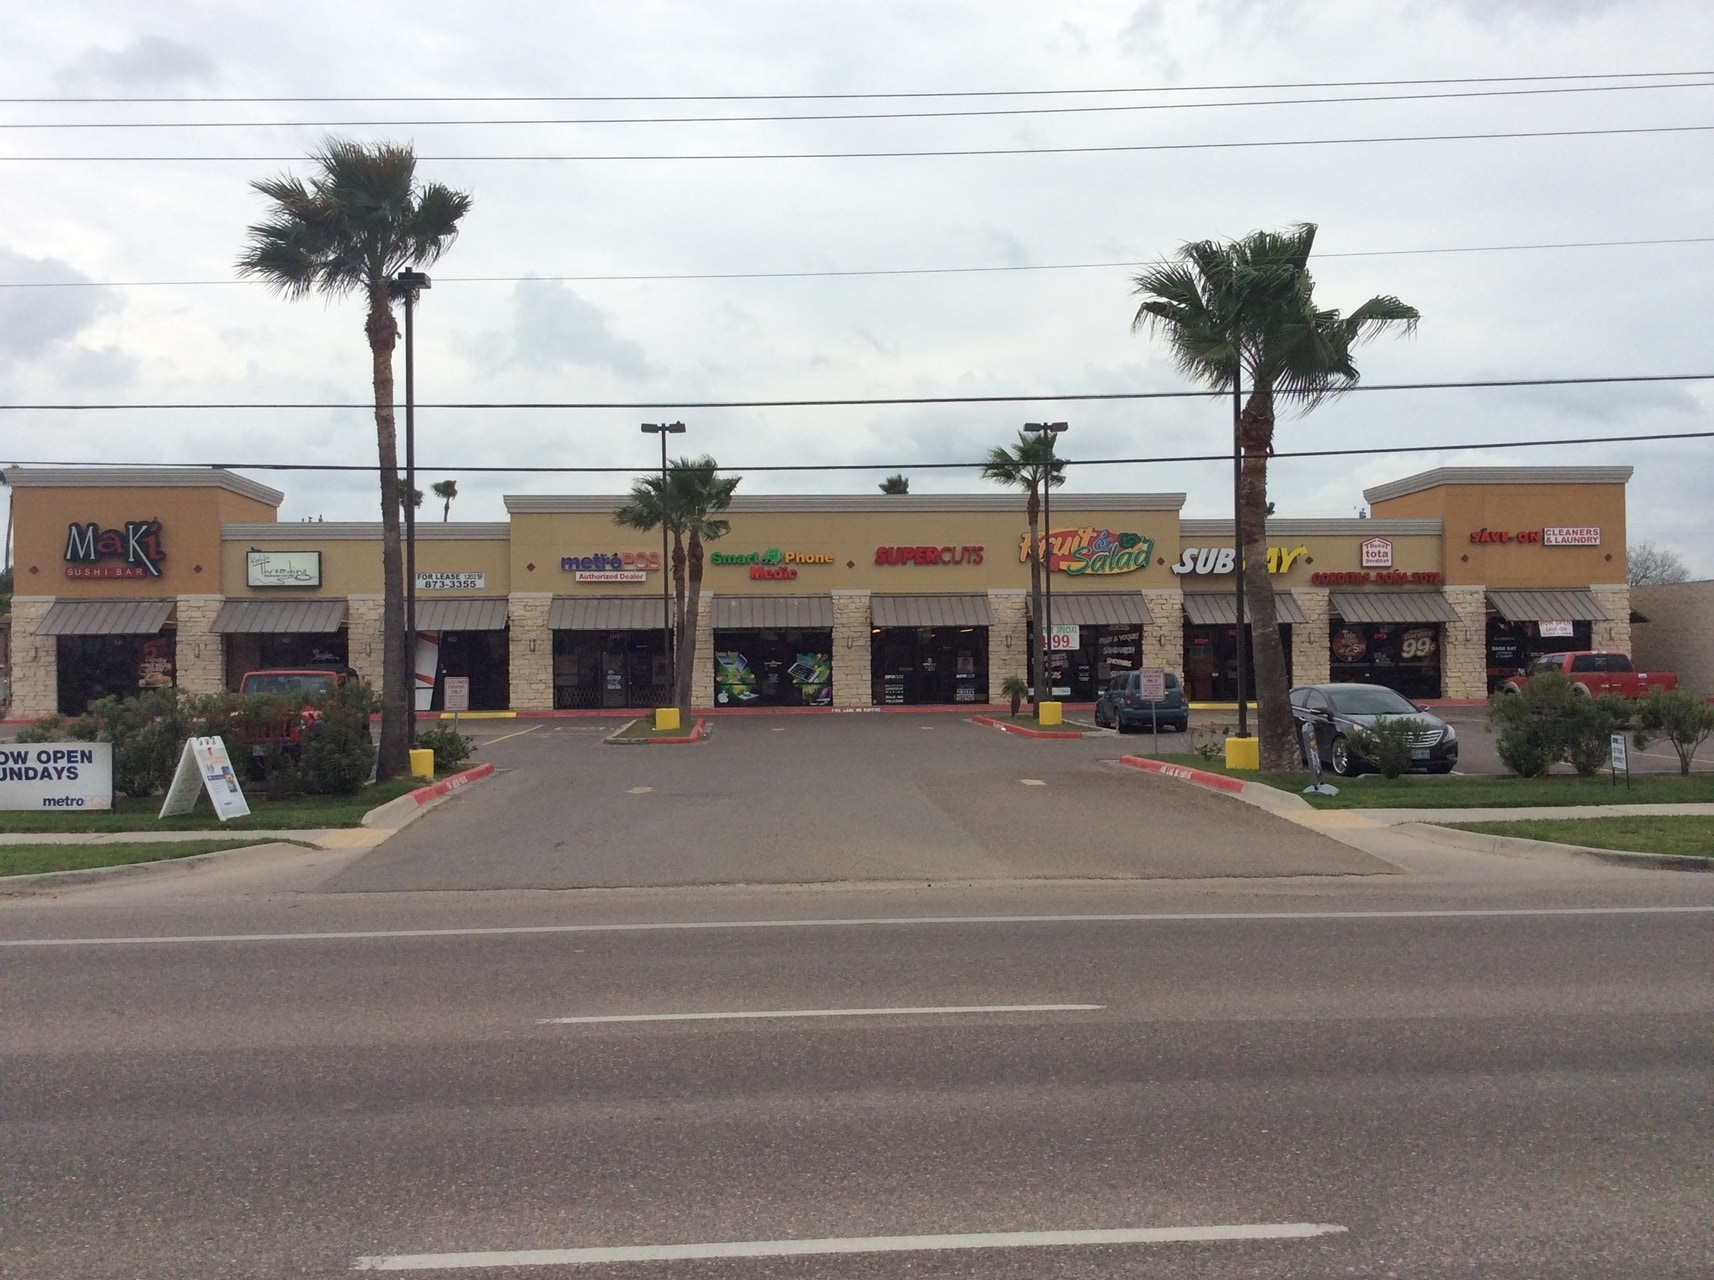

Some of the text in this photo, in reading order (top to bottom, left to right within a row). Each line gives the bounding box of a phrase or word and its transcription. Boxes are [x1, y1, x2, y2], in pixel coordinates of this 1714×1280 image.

[1545, 536, 1599, 544] & LAUNDRY
[711, 551, 834, 565] Smart Phone
[875, 546, 984, 565] SUPERCUTS
[1066, 541, 1154, 576] Salad
[1171, 545, 1309, 574] SUBAY
[1365, 550, 1389, 558] tota
[67, 568, 144, 576] SUSHI BAR
[749, 566, 798, 581] Medic
[425, 580, 477, 588] 873-3355
[0, 750, 93, 765] OW OPEN
[0, 766, 79, 781] UNDAYS
